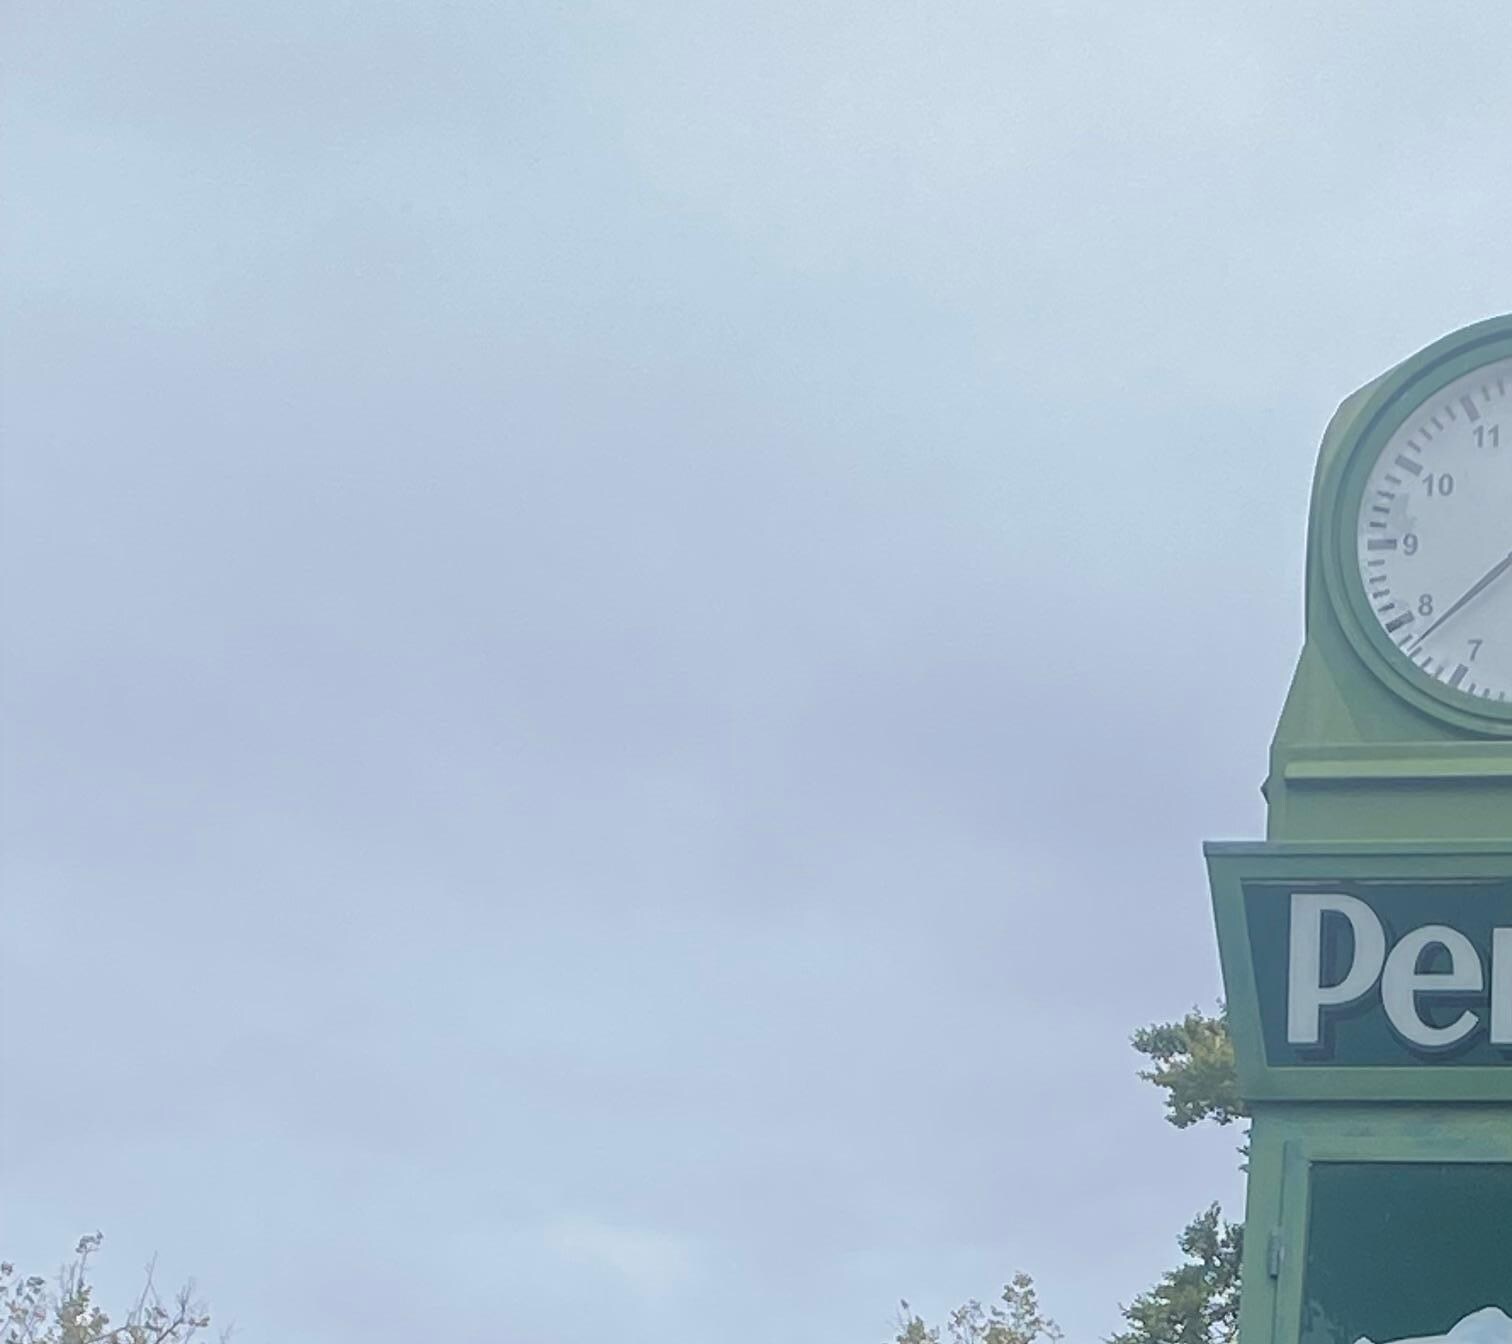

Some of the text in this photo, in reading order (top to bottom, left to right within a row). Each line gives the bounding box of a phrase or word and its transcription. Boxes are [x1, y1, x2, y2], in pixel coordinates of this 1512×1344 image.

[1473, 425, 1501, 449] 11
[1421, 473, 1455, 498] 10
[1402, 532, 1419, 556] 9
[1416, 593, 1435, 617] 8
[1467, 638, 1484, 662] 7
